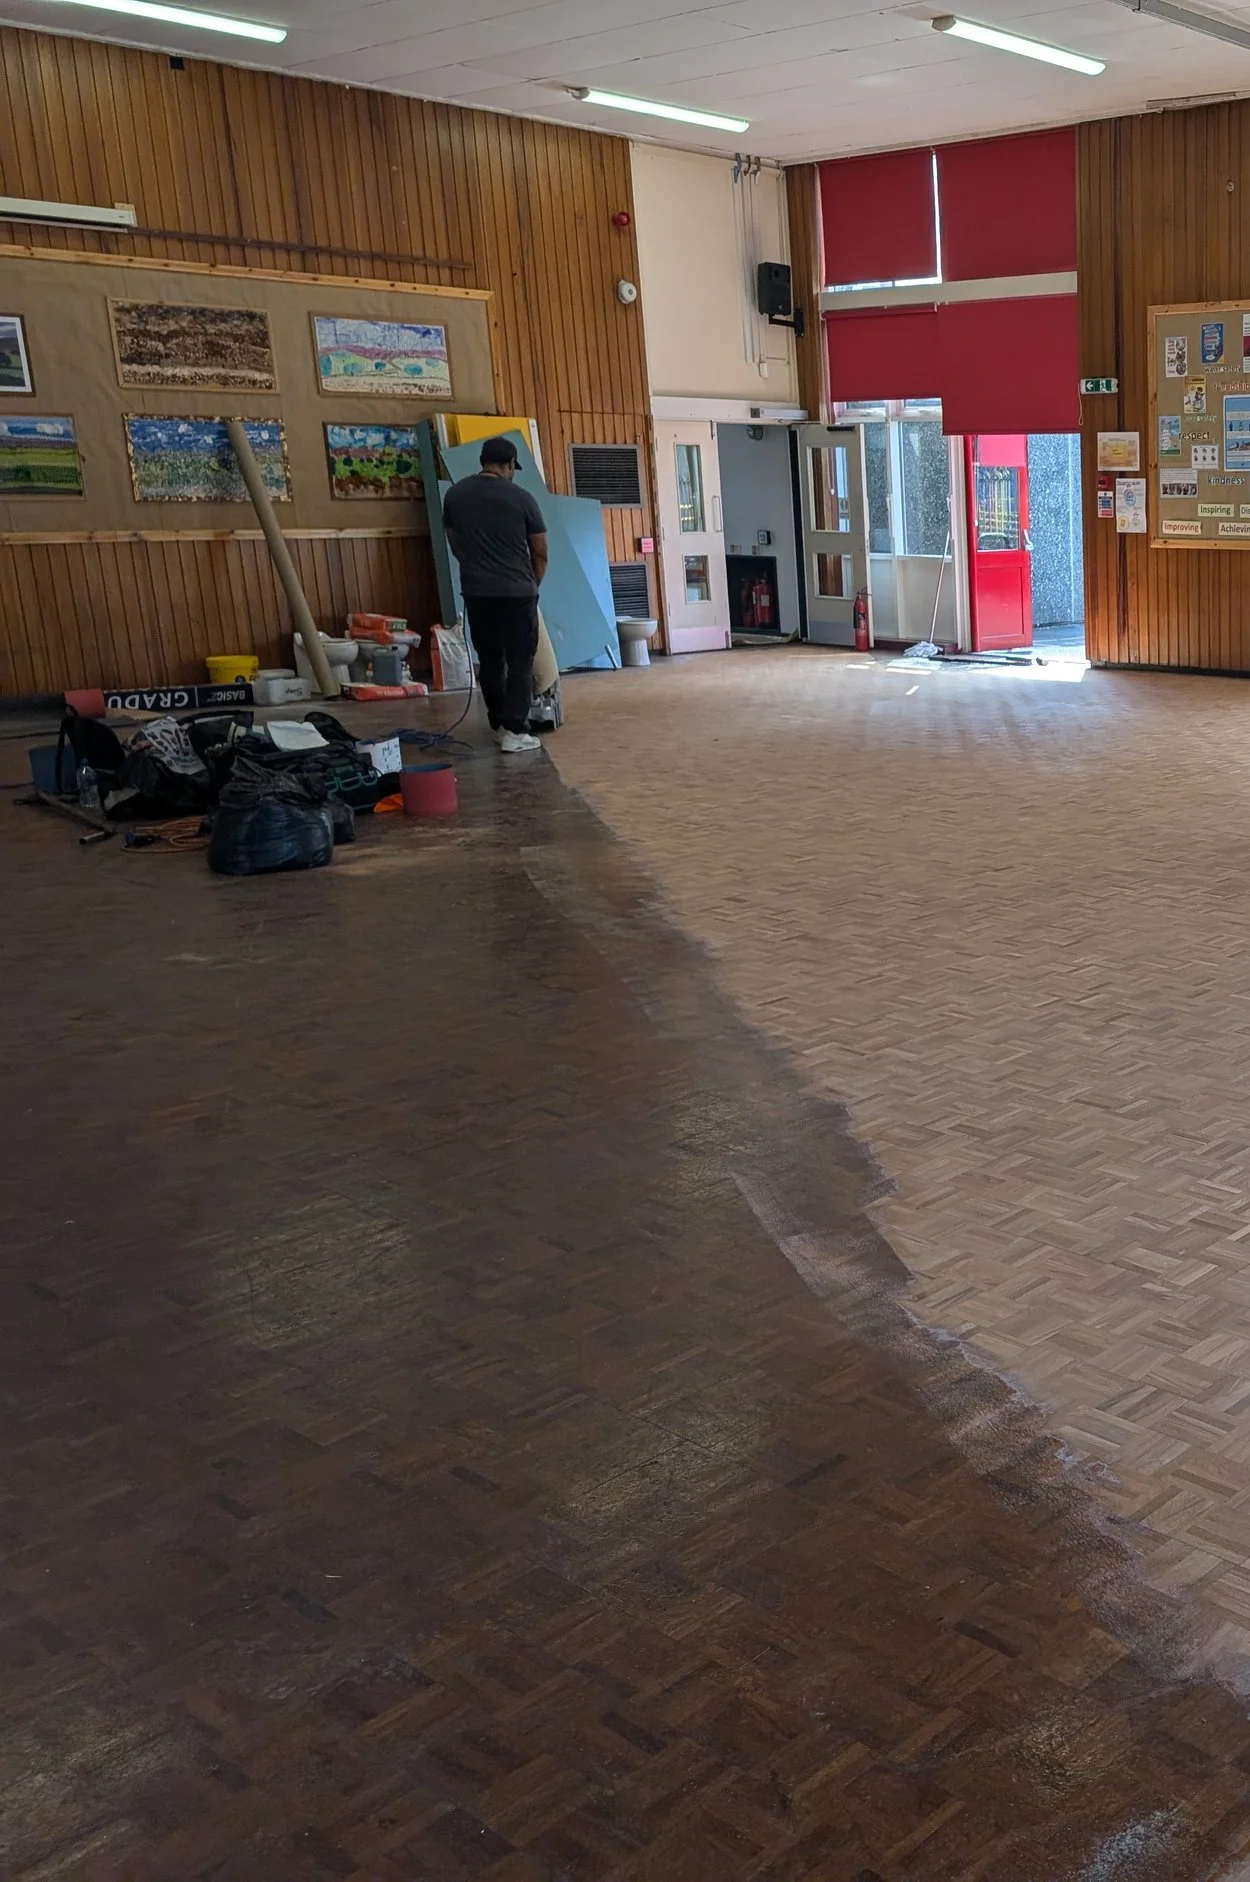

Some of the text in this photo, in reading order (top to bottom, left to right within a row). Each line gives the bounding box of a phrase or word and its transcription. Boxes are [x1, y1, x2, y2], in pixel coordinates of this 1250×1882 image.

[1178, 431, 1210, 441] respect
[1208, 476, 1245, 485] kindness
[1200, 505, 1231, 515] Inspiring
[1164, 523, 1199, 533] Improving
